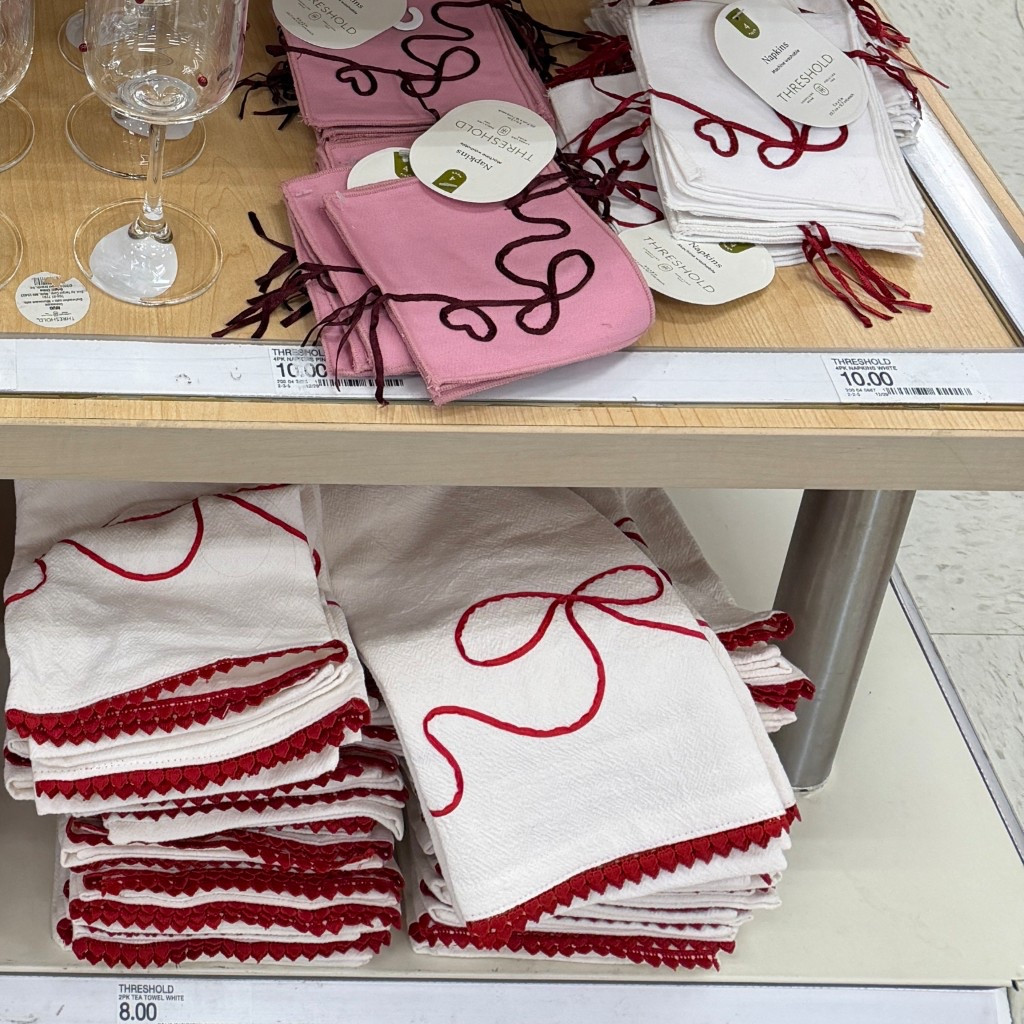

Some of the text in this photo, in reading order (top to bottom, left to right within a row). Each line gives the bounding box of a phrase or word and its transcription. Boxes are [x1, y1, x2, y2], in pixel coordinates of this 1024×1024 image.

[743, 22, 750, 30] 4
[761, 41, 790, 65] Napkins
[771, 48, 801, 74] Machine washable
[776, 53, 834, 103] THRESHOLD
[455, 119, 534, 163] THRESHOLD
[456, 148, 493, 172] Napkins
[643, 236, 716, 293] THRESHOLD
[688, 241, 723, 269] Napkins
[271, 348, 326, 356] THRESHOL
[840, 371, 894, 386] 10.00
[118, 984, 174, 994] THRESHOLD
[119, 1002, 157, 1021] 8.00
